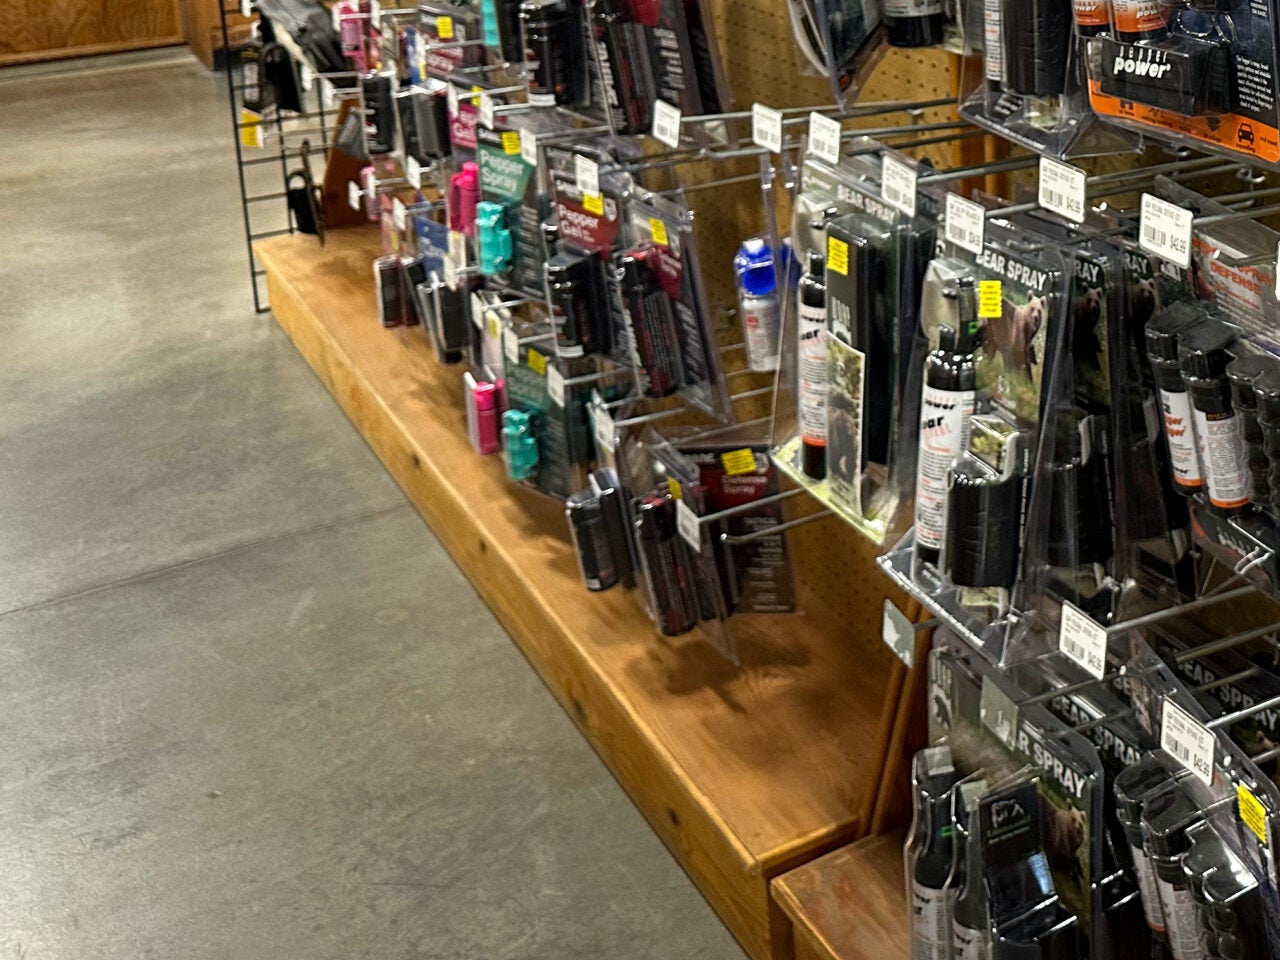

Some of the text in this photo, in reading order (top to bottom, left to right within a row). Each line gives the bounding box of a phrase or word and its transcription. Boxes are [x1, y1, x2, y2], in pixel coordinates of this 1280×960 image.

[1113, 55, 1167, 79] power
[479, 148, 524, 178] Pepper
[558, 202, 599, 229] Pepper
[1006, 259, 1047, 291] SPRAY
[1032, 745, 1088, 798] SPRAY
